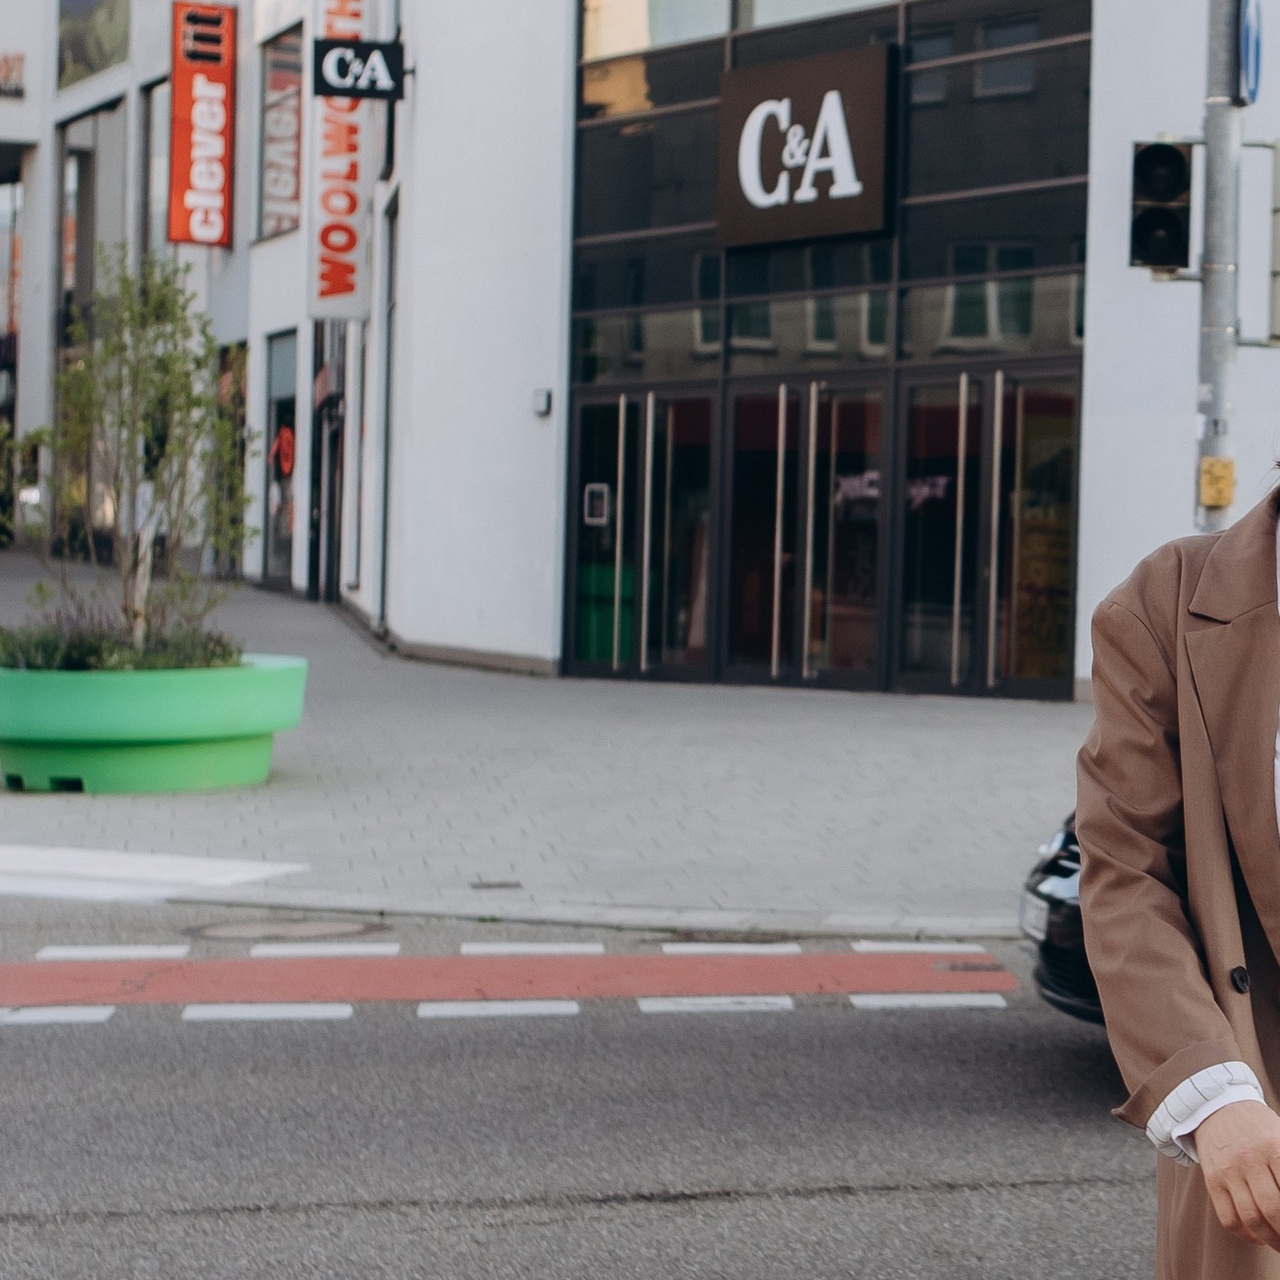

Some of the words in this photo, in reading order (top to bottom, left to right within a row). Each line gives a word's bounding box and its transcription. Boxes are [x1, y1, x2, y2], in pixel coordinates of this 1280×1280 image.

[184, 10, 222, 62] fit
[322, 47, 395, 91] C&A
[183, 73, 227, 244] clever
[738, 89, 864, 209] C&A
